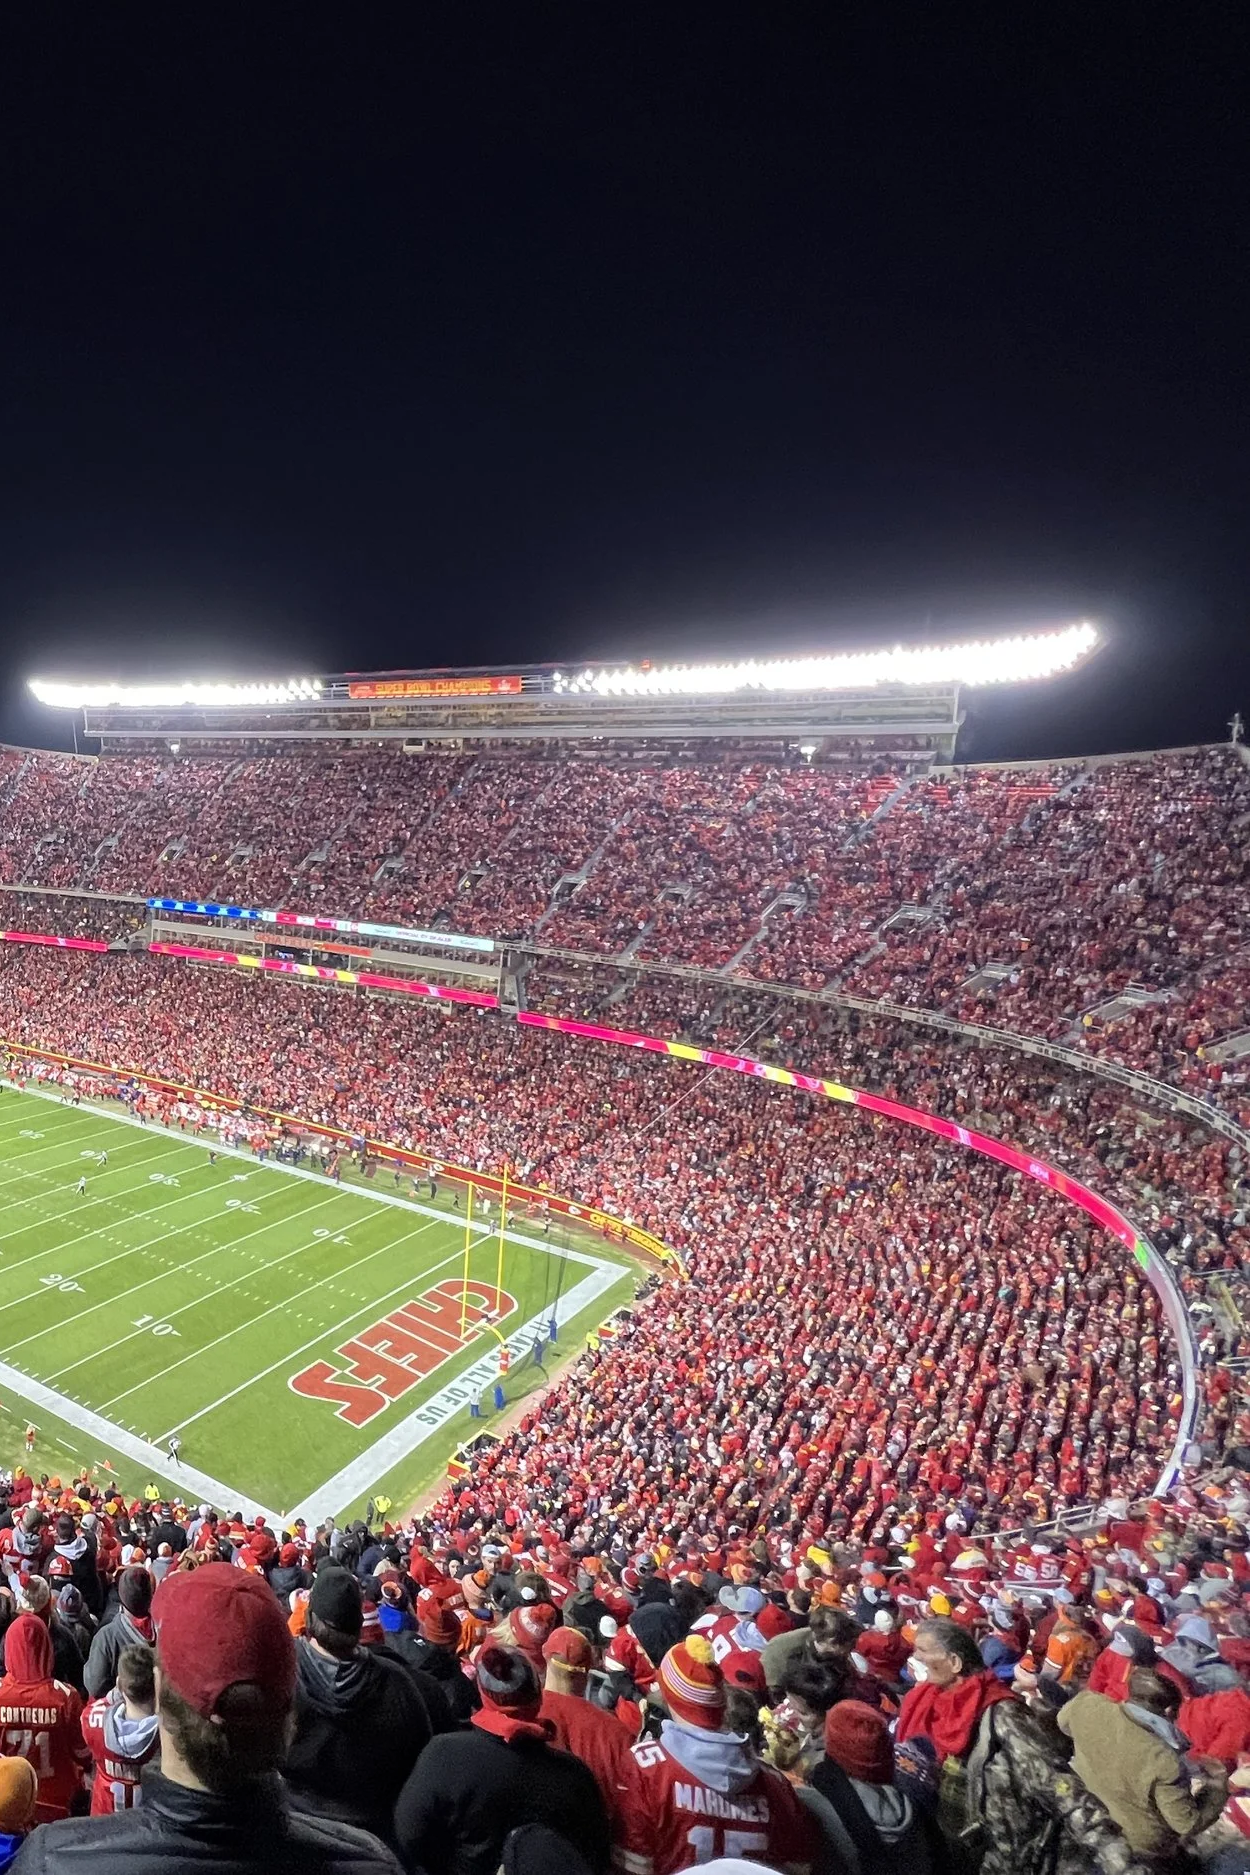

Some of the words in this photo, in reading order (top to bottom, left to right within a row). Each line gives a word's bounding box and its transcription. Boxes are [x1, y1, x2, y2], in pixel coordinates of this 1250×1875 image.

[375, 683, 405, 695] SUPER
[407, 682, 431, 694] BOWL
[435, 680, 492, 693] CHAMPIONS
[38, 1273, 78, 1293] 20
[129, 1313, 173, 1337] 10
[288, 1279, 518, 1429] CHIEFS
[459, 1363, 496, 1386] ALL
[440, 1386, 470, 1406] OF
[415, 1405, 448, 1425] US
[0, 1705, 58, 1725] CONTRERAS
[5, 1729, 55, 1779] 71
[629, 1740, 667, 1769] 15
[674, 1780, 770, 1824] MAHOMES
